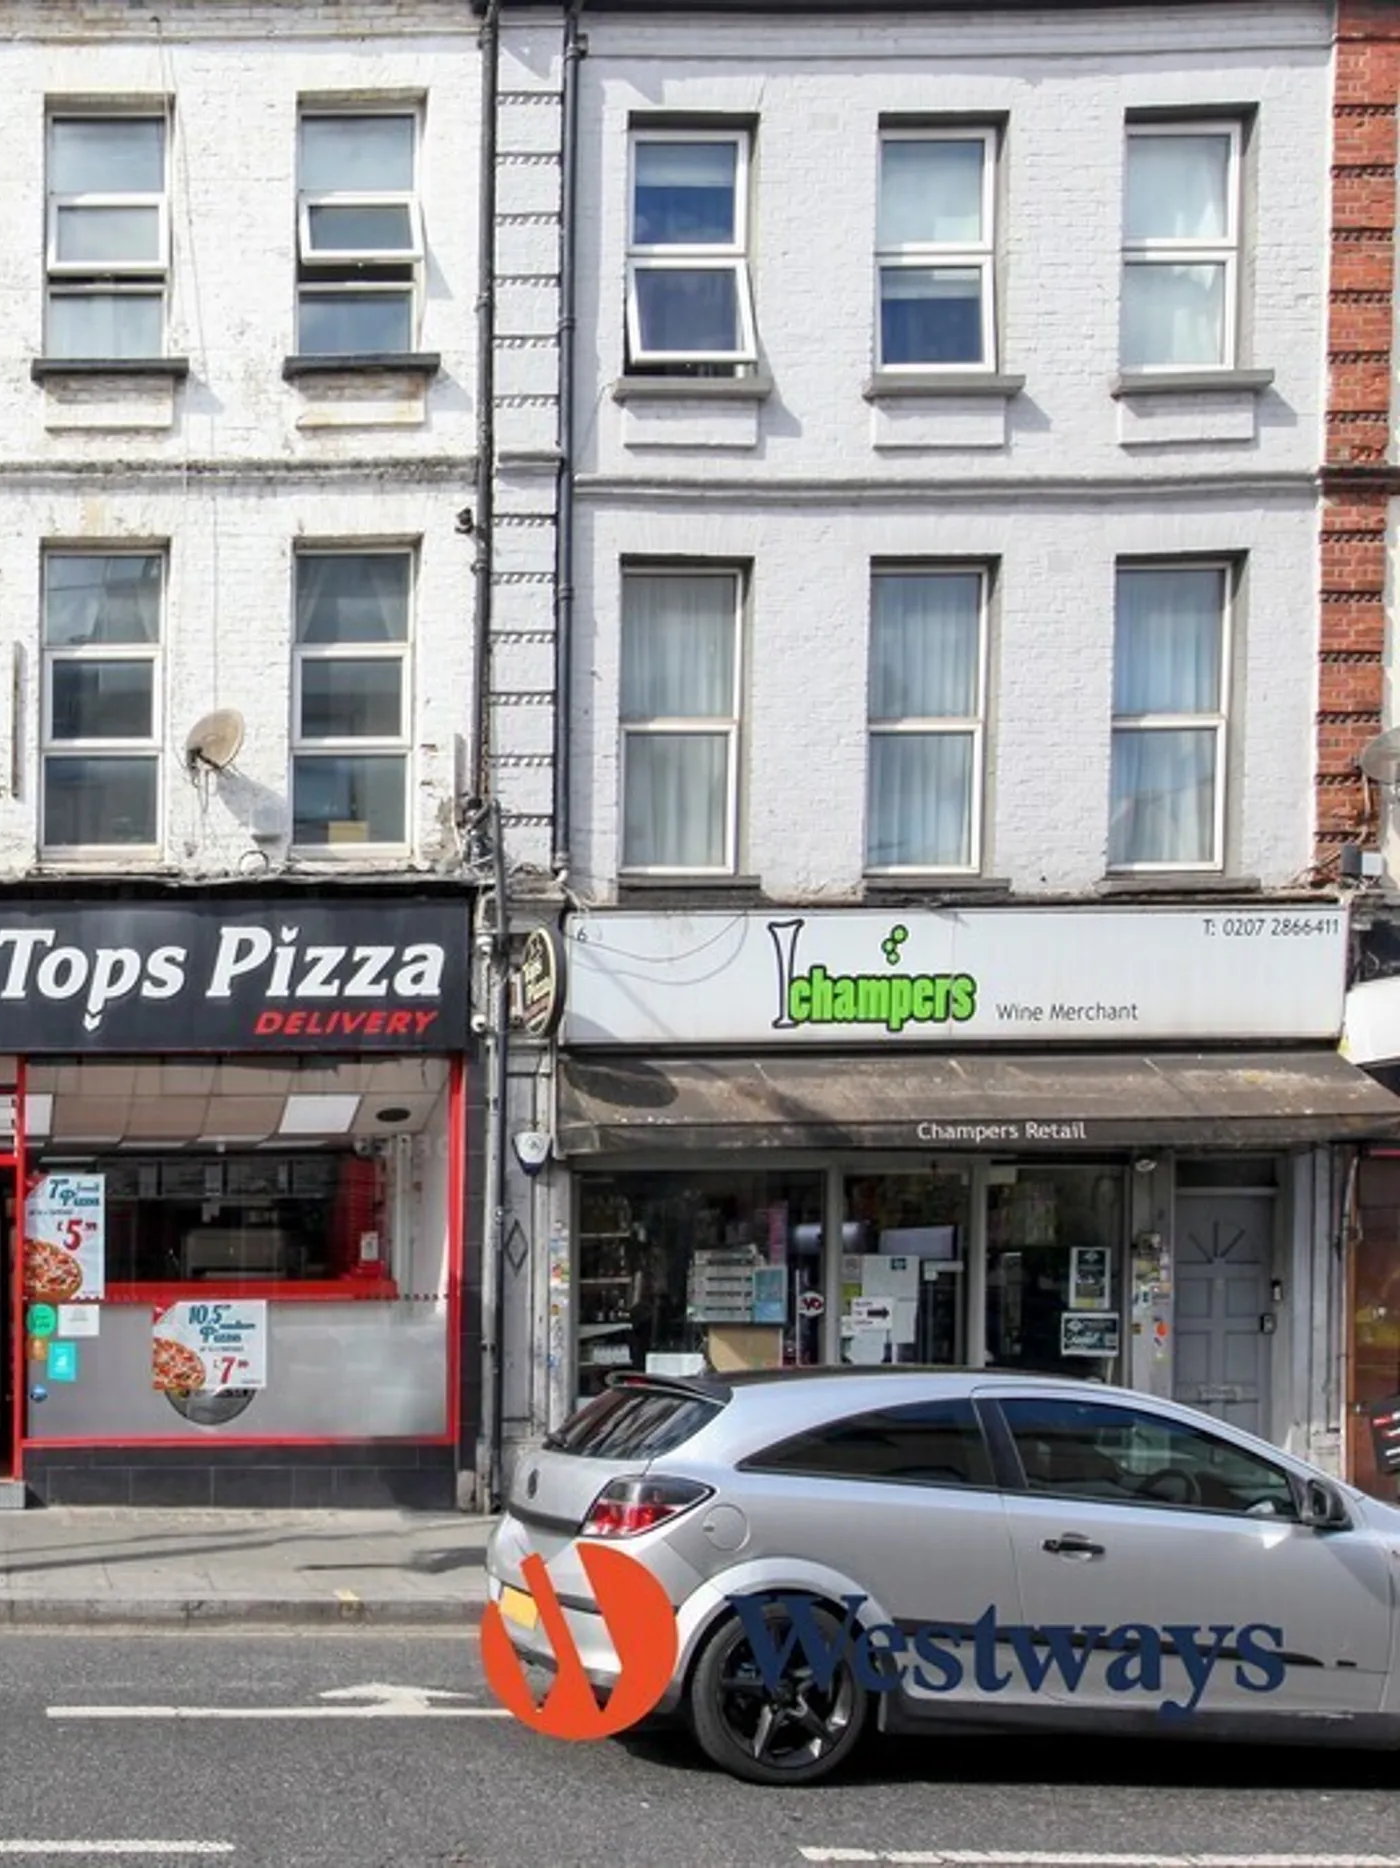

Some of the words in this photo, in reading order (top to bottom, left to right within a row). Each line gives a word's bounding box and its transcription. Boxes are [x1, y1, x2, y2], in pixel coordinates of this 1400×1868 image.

[577, 927, 588, 943] 6
[1222, 918, 1266, 936] 0207
[1271, 918, 1339, 936] 2866411
[205, 926, 446, 998] Pizza
[789, 965, 977, 1031] champers
[255, 1009, 439, 1035] DELIVERY
[996, 1003, 1044, 1021] Wine
[1049, 1002, 1139, 1021] Merchant
[916, 1122, 1019, 1142] Champers
[1025, 1121, 1086, 1140] Retail
